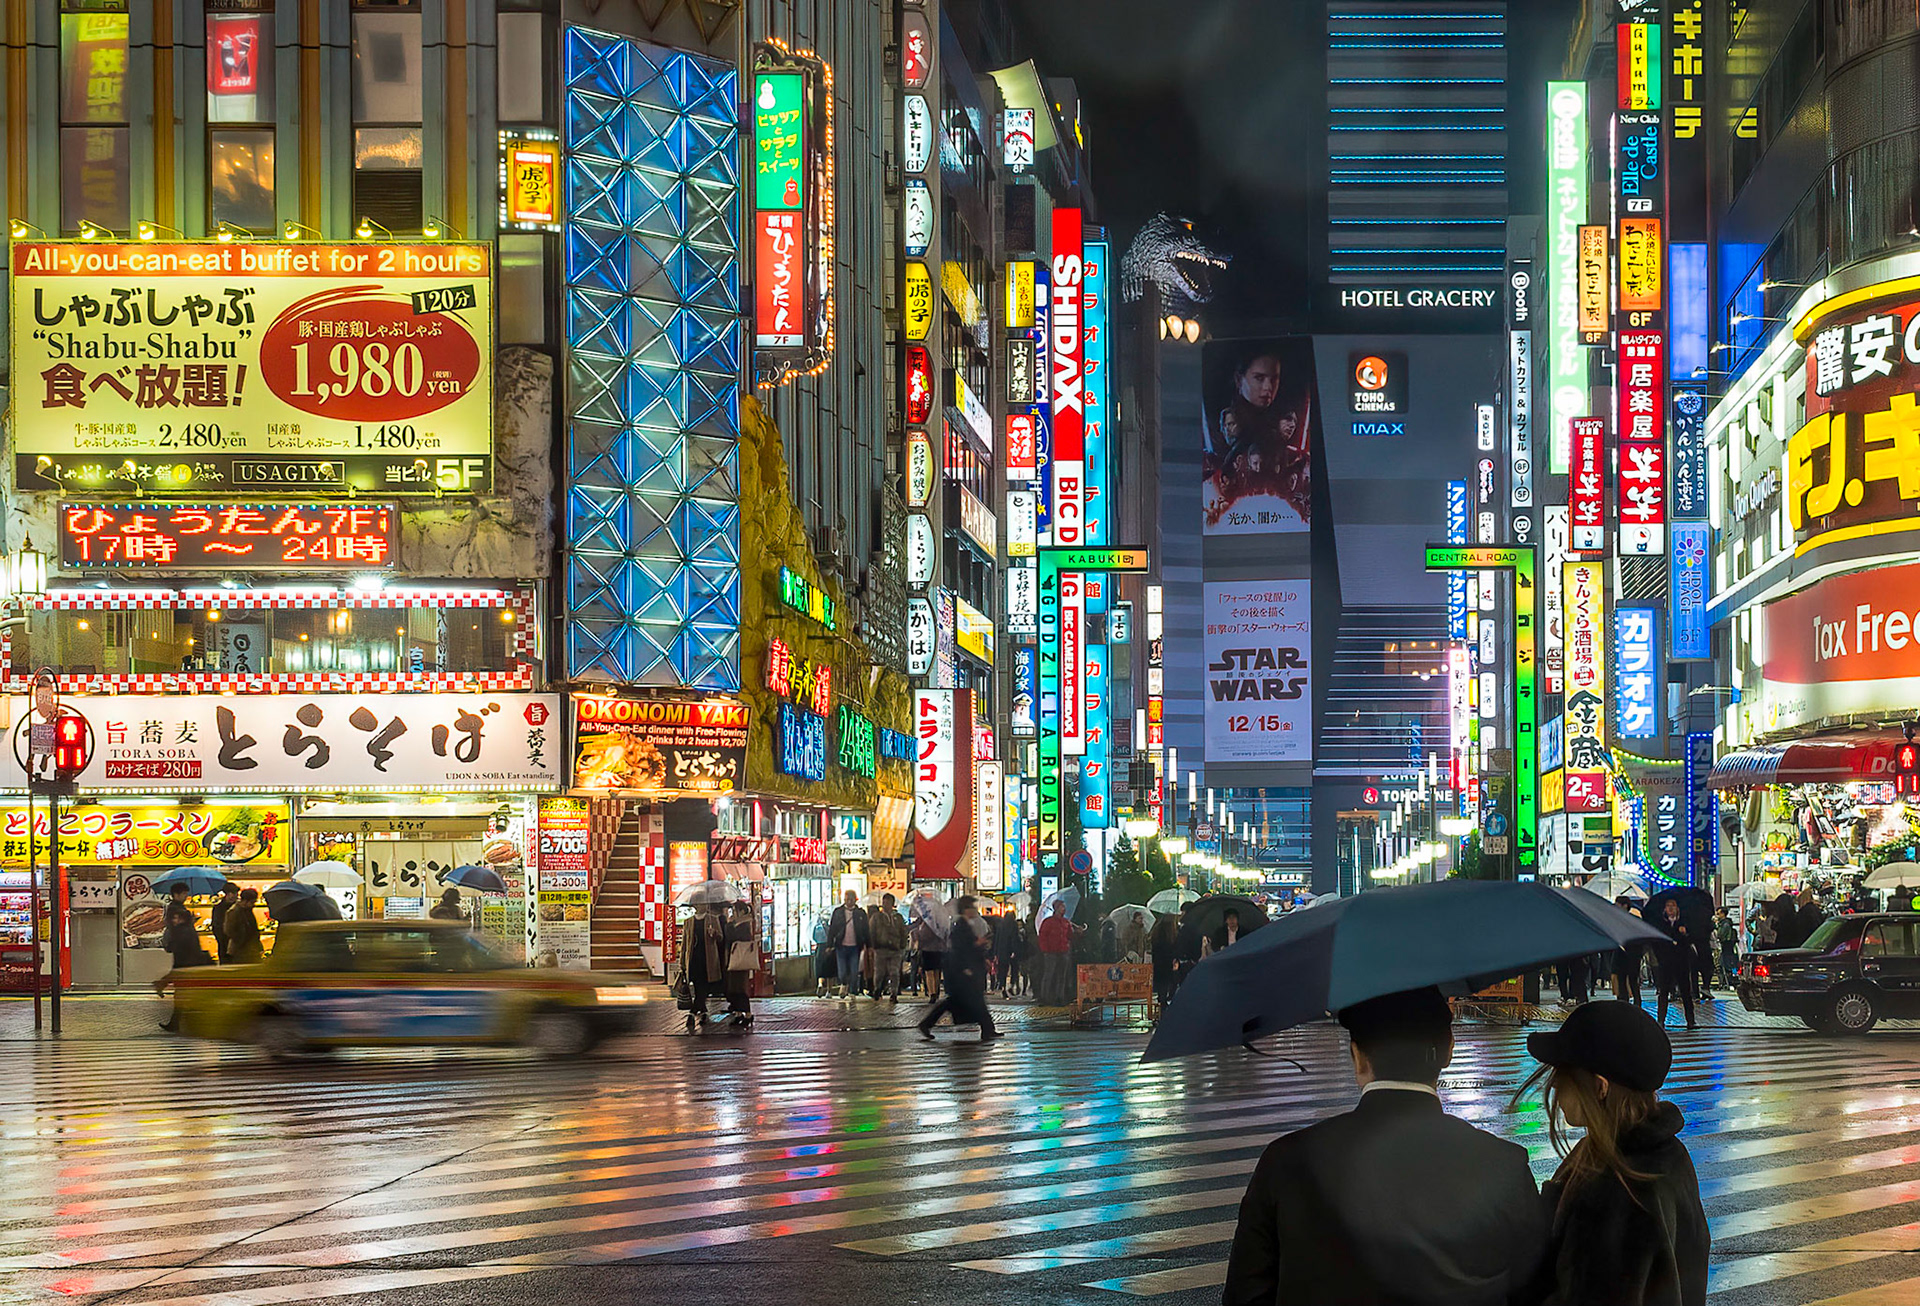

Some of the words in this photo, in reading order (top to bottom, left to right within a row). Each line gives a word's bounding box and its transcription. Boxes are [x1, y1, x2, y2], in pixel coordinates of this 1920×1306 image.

[1620, 116, 1638, 124] New
[1640, 115, 1660, 124] Club
[1622, 135, 1639, 158] de
[1640, 127, 1657, 180] Castle
[759, 158, 799, 173] スイーツ
[1622, 159, 1640, 195] Elle
[1631, 201, 1650, 210] 7F
[25, 249, 232, 275] All-you-can-eat
[242, 248, 323, 272] buffet
[328, 248, 369, 272] for
[378, 251, 396, 272] 2
[404, 249, 482, 272] hours
[766, 230, 794, 332] ひょうたん
[34, 287, 255, 327] しゃぶしゃぶ
[416, 289, 471, 314] 120分
[1341, 290, 1404, 307] HOTEL
[1407, 290, 1495, 307] GRACERY
[1629, 312, 1652, 326] 6F
[774, 336, 789, 345] 7F
[1053, 253, 1082, 415] SHIDAX
[1585, 333, 1601, 342] 6F
[41, 363, 247, 409] 食べ放題!
[290, 341, 424, 405] 1,980
[427, 378, 461, 396] yen
[1354, 392, 1384, 402] TOHO
[1354, 402, 1396, 412] CINEMAS
[1629, 363, 1654, 439] 居楽屋
[158, 423, 222, 449] 2,480
[222, 436, 247, 449] yen
[354, 424, 416, 451] 1,480
[416, 436, 441, 450] yen
[1353, 423, 1404, 435] IMAX
[436, 459, 484, 489] 5F
[1676, 416, 1694, 511] かんかん商店
[1059, 477, 1078, 520] BIC
[76, 535, 178, 563] 17時
[283, 535, 388, 563] 24時
[1015, 544, 1030, 553] 3F
[1430, 553, 1483, 562] CENTRAL
[1486, 553, 1517, 562] ROAD
[1680, 571, 1691, 616] STAGE
[1690, 571, 1702, 607] IDOL
[1064, 610, 1074, 629] BIC
[1574, 567, 1593, 664] きんくら酒場
[910, 612, 926, 655] かっぱ
[1680, 629, 1701, 643] 5F
[1812, 614, 1848, 663] Tax
[1855, 603, 1920, 654] Fre
[911, 660, 927, 670] B1
[1014, 650, 1030, 692] 海の家
[1041, 595, 1057, 741] GODZILLA
[1208, 647, 1308, 672] STAR
[1621, 612, 1655, 732] カラオケ
[1209, 677, 1308, 702] WARS
[580, 699, 691, 724] OKONOMI
[697, 705, 750, 726] YAKI
[1518, 613, 1533, 805] ゴジラロード
[579, 722, 647, 734] All-You-Can-Eat
[648, 726, 676, 734] dinner
[676, 727, 695, 735] with
[1085, 660, 1103, 811] カラオケ館
[1227, 714, 1280, 732] 12/15
[1567, 689, 1604, 770] 金の蔵
[216, 702, 501, 772] とらそば
[646, 735, 674, 744] Drinks
[674, 737, 688, 745] for
[688, 737, 695, 745] 2
[695, 738, 720, 746] hours
[720, 739, 747, 748] ¥2,700
[918, 697, 939, 782] トラノコ
[110, 749, 152, 759] TORA
[157, 749, 196, 759] SOBA
[107, 762, 160, 776] かけそば
[162, 761, 200, 778] 280円
[445, 772, 472, 780] UDON
[482, 772, 506, 780] SOBA
[507, 772, 520, 780] Eat
[522, 772, 555, 781] standing
[1041, 756, 1057, 824] ROAD
[1567, 776, 1593, 798] 2F
[1657, 794, 1679, 872] カラオケ
